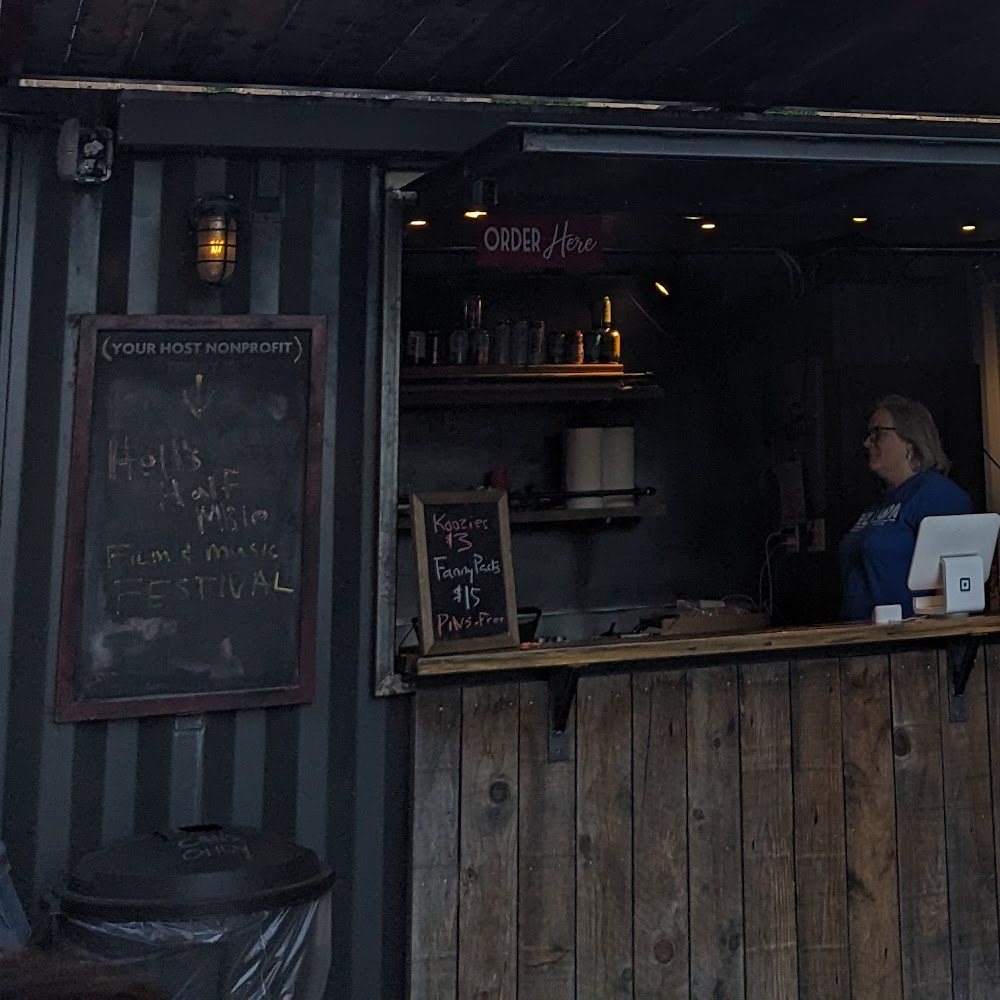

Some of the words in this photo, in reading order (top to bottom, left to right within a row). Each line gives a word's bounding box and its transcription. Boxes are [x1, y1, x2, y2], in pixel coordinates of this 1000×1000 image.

[484, 226, 541, 252] ORDER
[543, 220, 597, 259] Here
[160, 341, 202, 355] HOST
[433, 513, 489, 533] Koozies
[445, 532, 473, 552] $3
[433, 555, 474, 584] Fanny
[113, 569, 295, 616] FESTIVAL
[453, 584, 481, 610] $15
